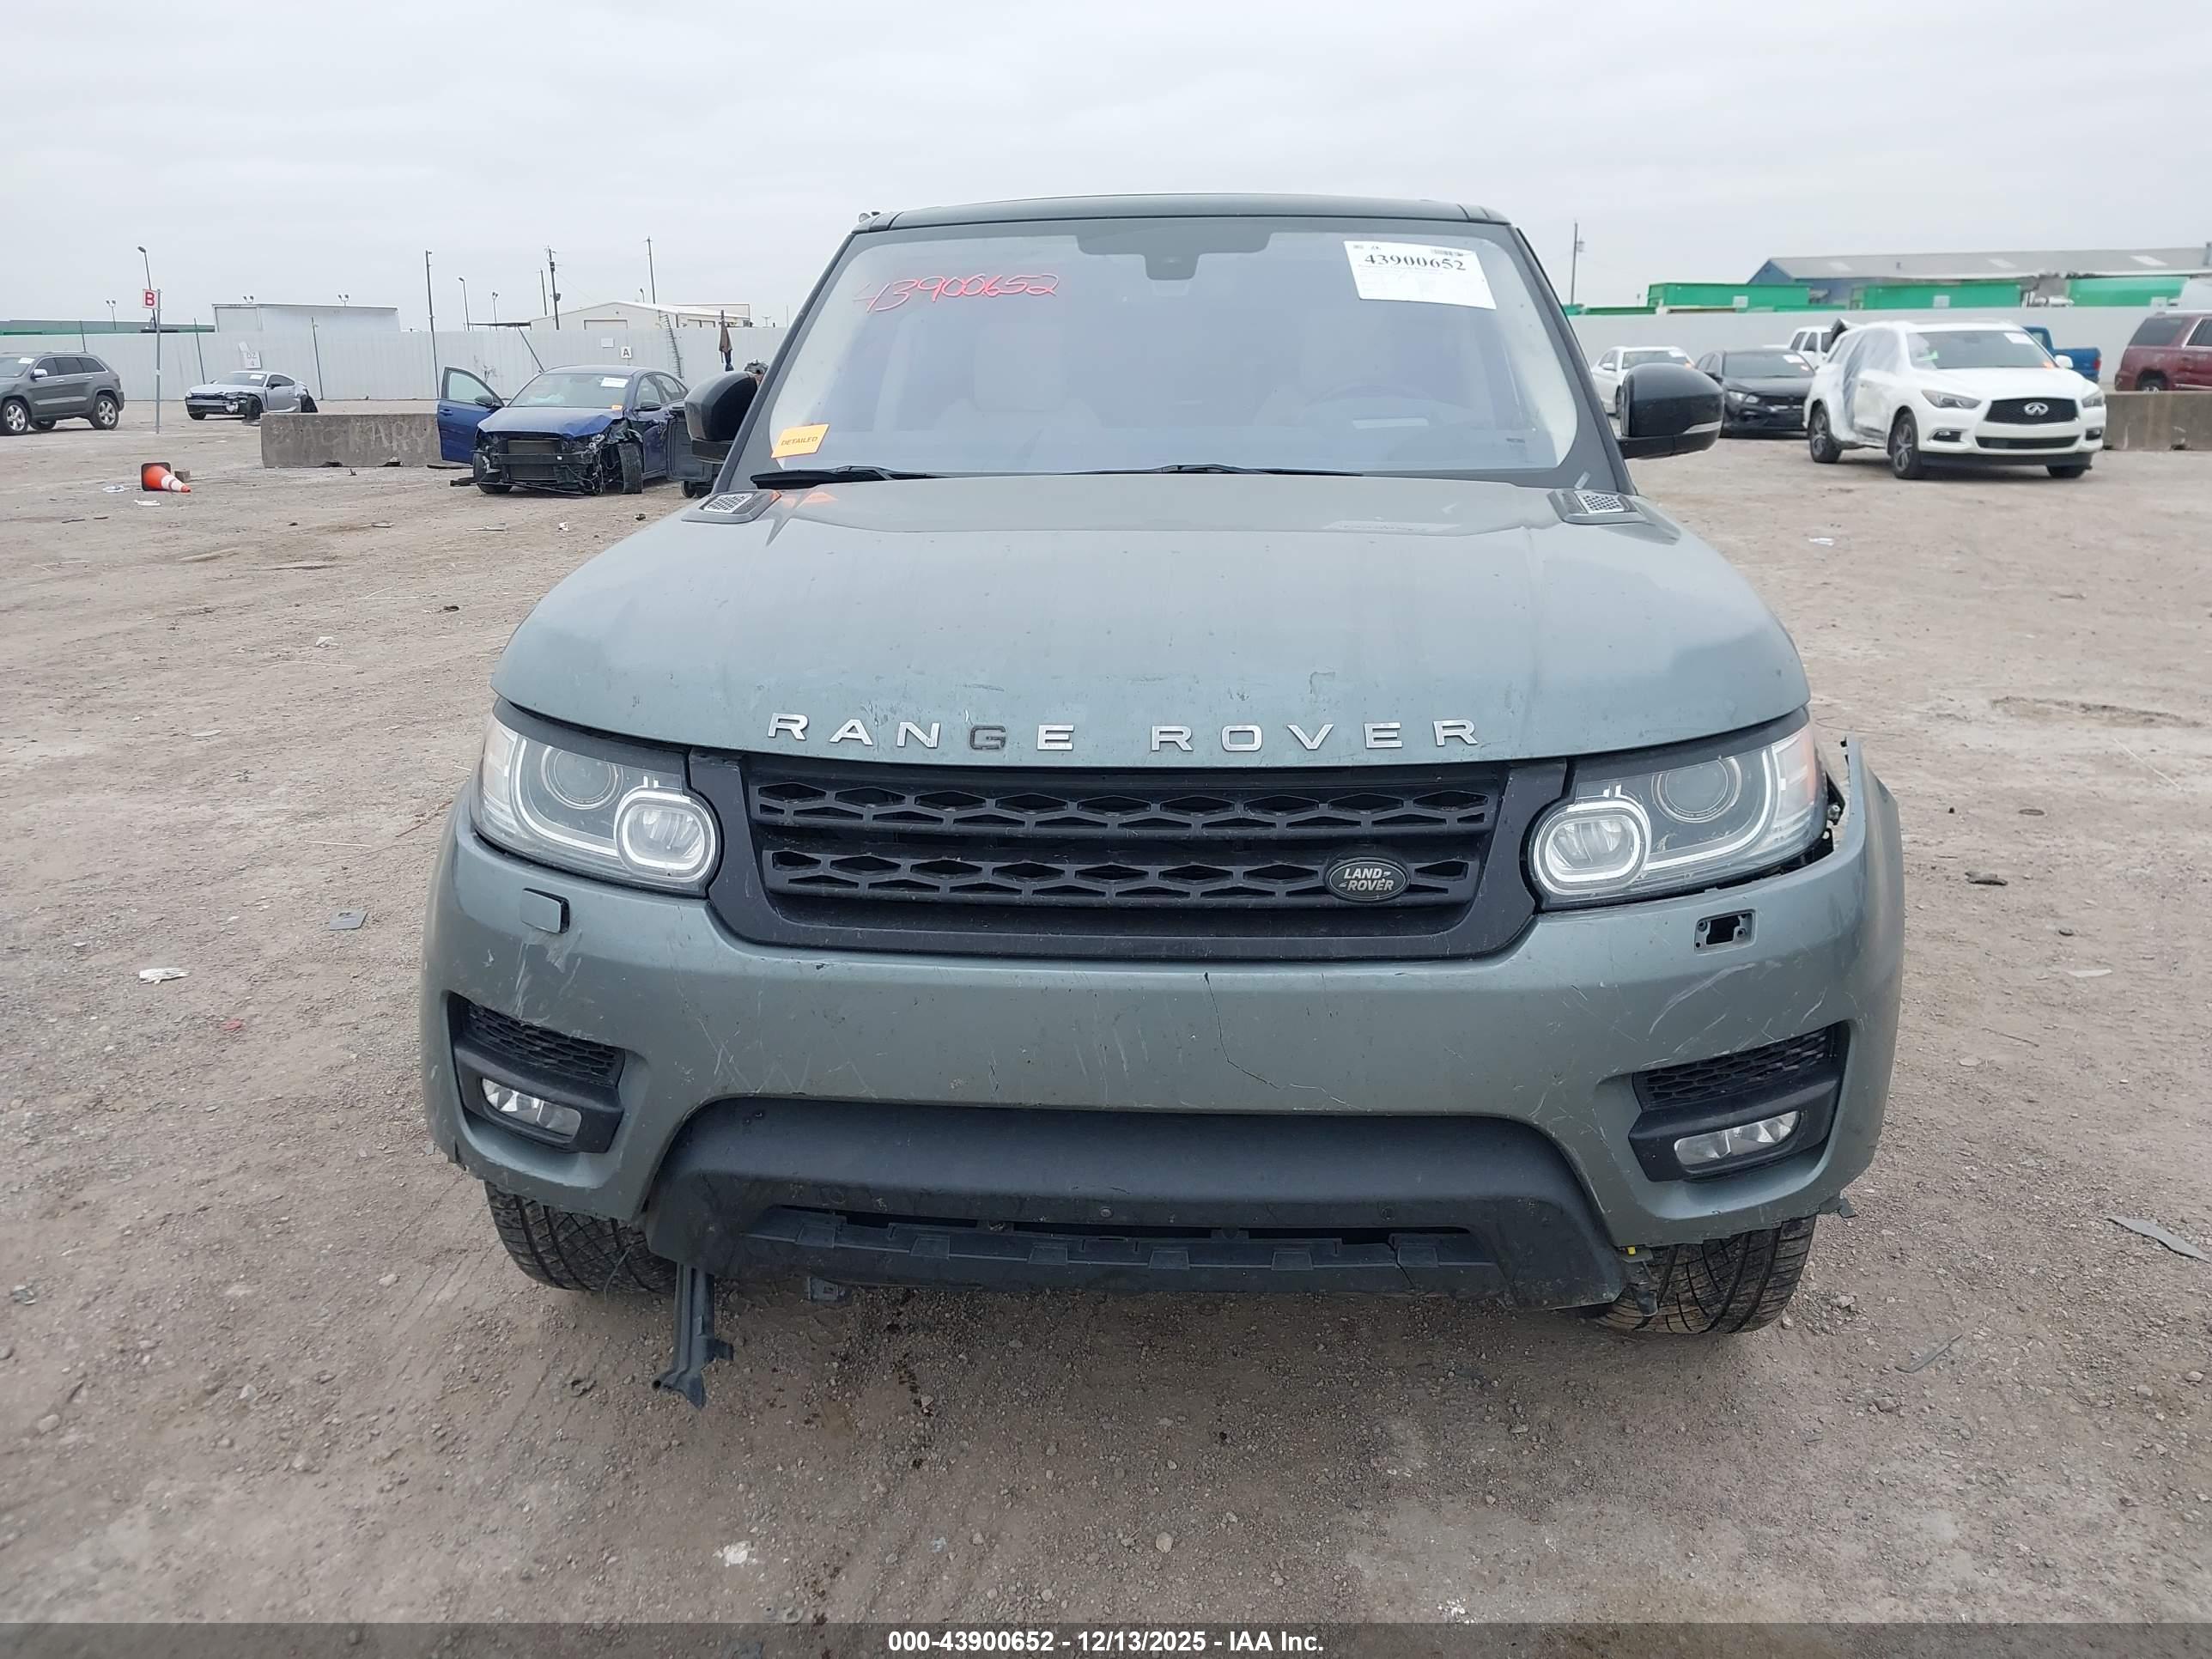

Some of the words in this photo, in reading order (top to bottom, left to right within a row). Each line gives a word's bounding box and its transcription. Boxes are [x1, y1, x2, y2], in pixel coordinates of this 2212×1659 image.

[1364, 254, 1468, 271] 43900652
[145, 292, 155, 307] B
[853, 273, 1059, 313] 43900652
[623, 348, 630, 357] A
[781, 436, 818, 446] DETAILED
[767, 712, 1075, 751] RANGE
[1150, 719, 1479, 752] ROVER
[1343, 867, 1382, 879] LAND
[1346, 879, 1395, 891] ROVER
